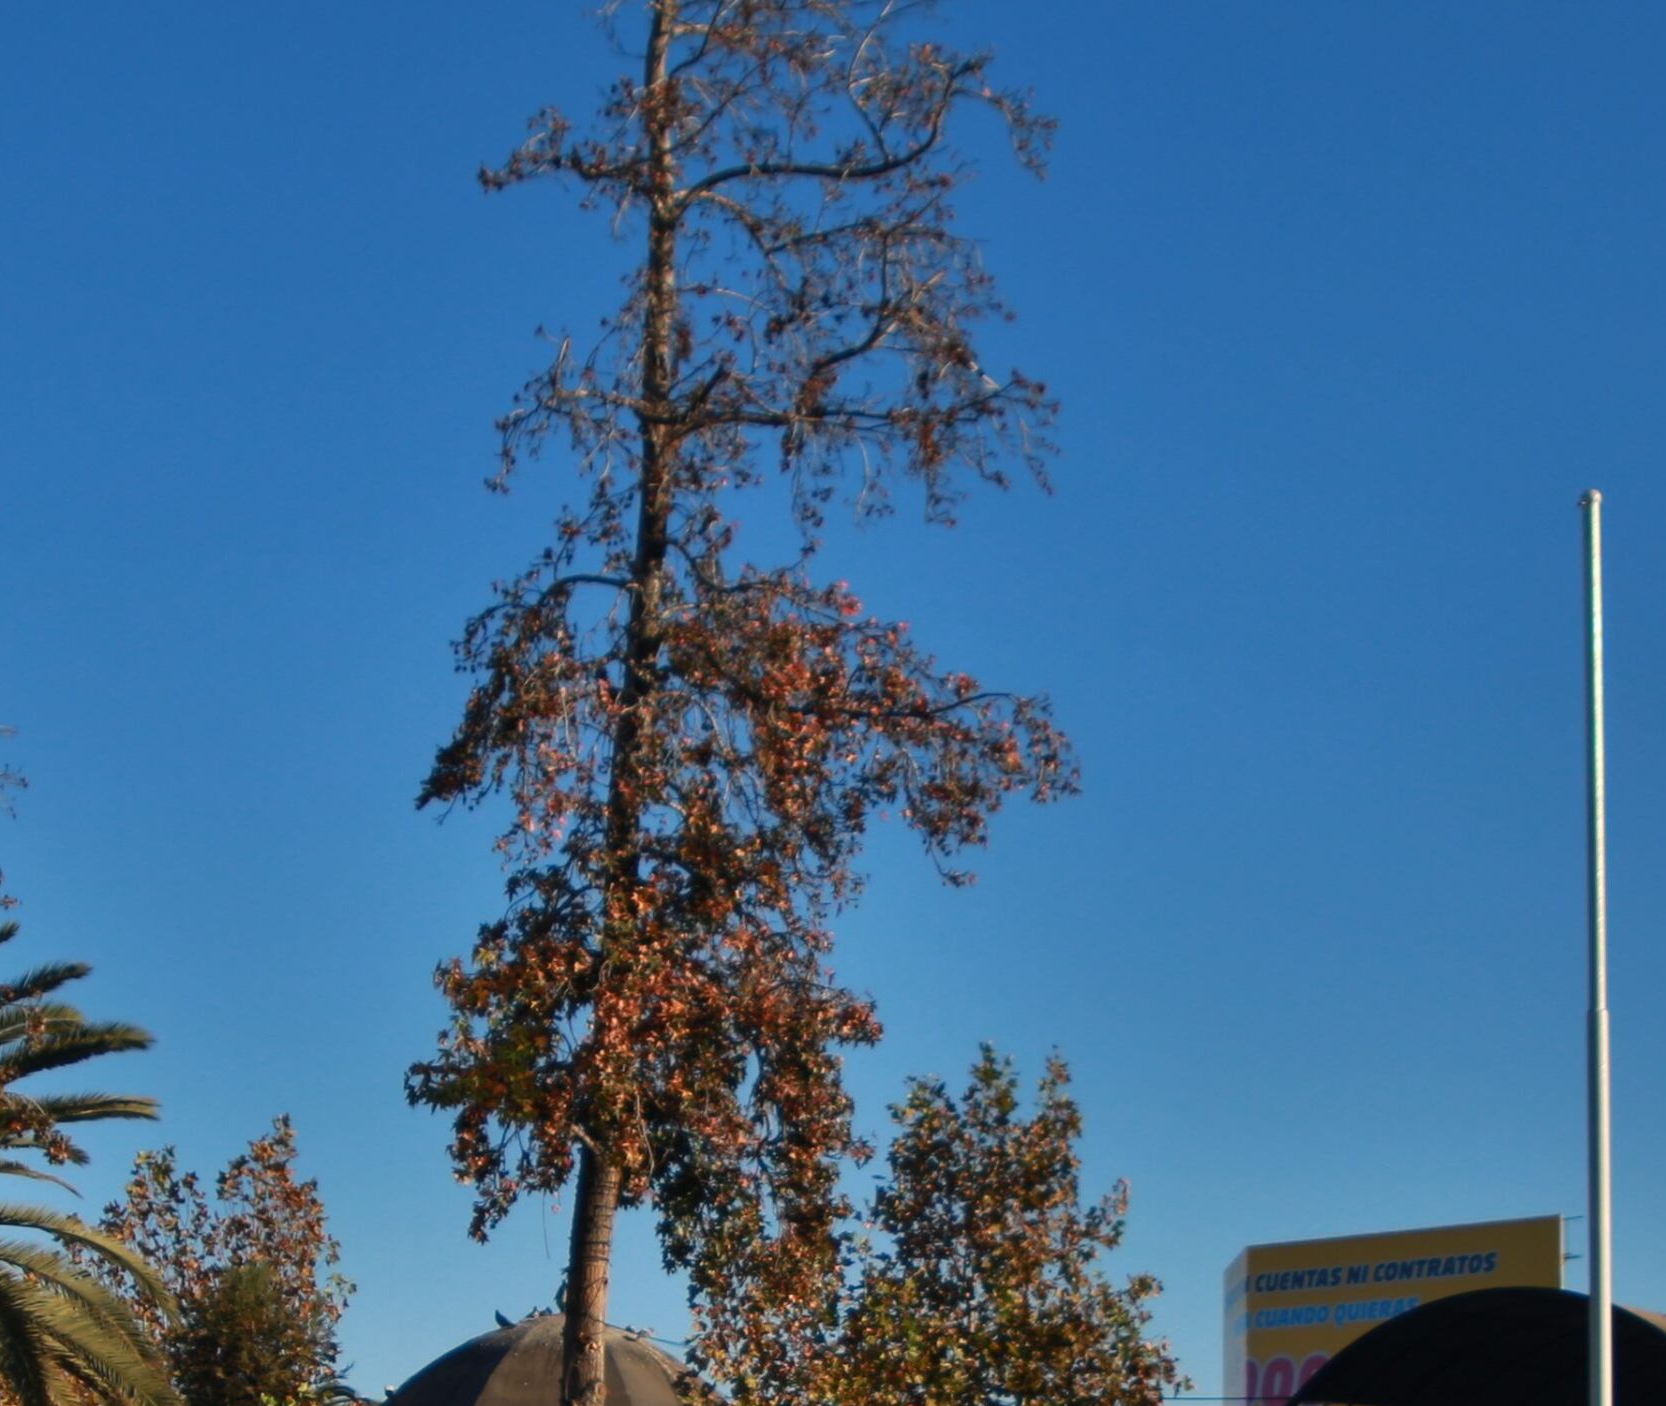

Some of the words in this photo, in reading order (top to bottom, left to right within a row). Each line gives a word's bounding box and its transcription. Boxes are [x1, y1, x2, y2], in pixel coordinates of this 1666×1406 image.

[1255, 1268, 1343, 1293] CUENTAS
[1346, 1264, 1371, 1285] NI
[1374, 1252, 1497, 1282] CONTRATOS
[1256, 1306, 1329, 1328] CUANDO
